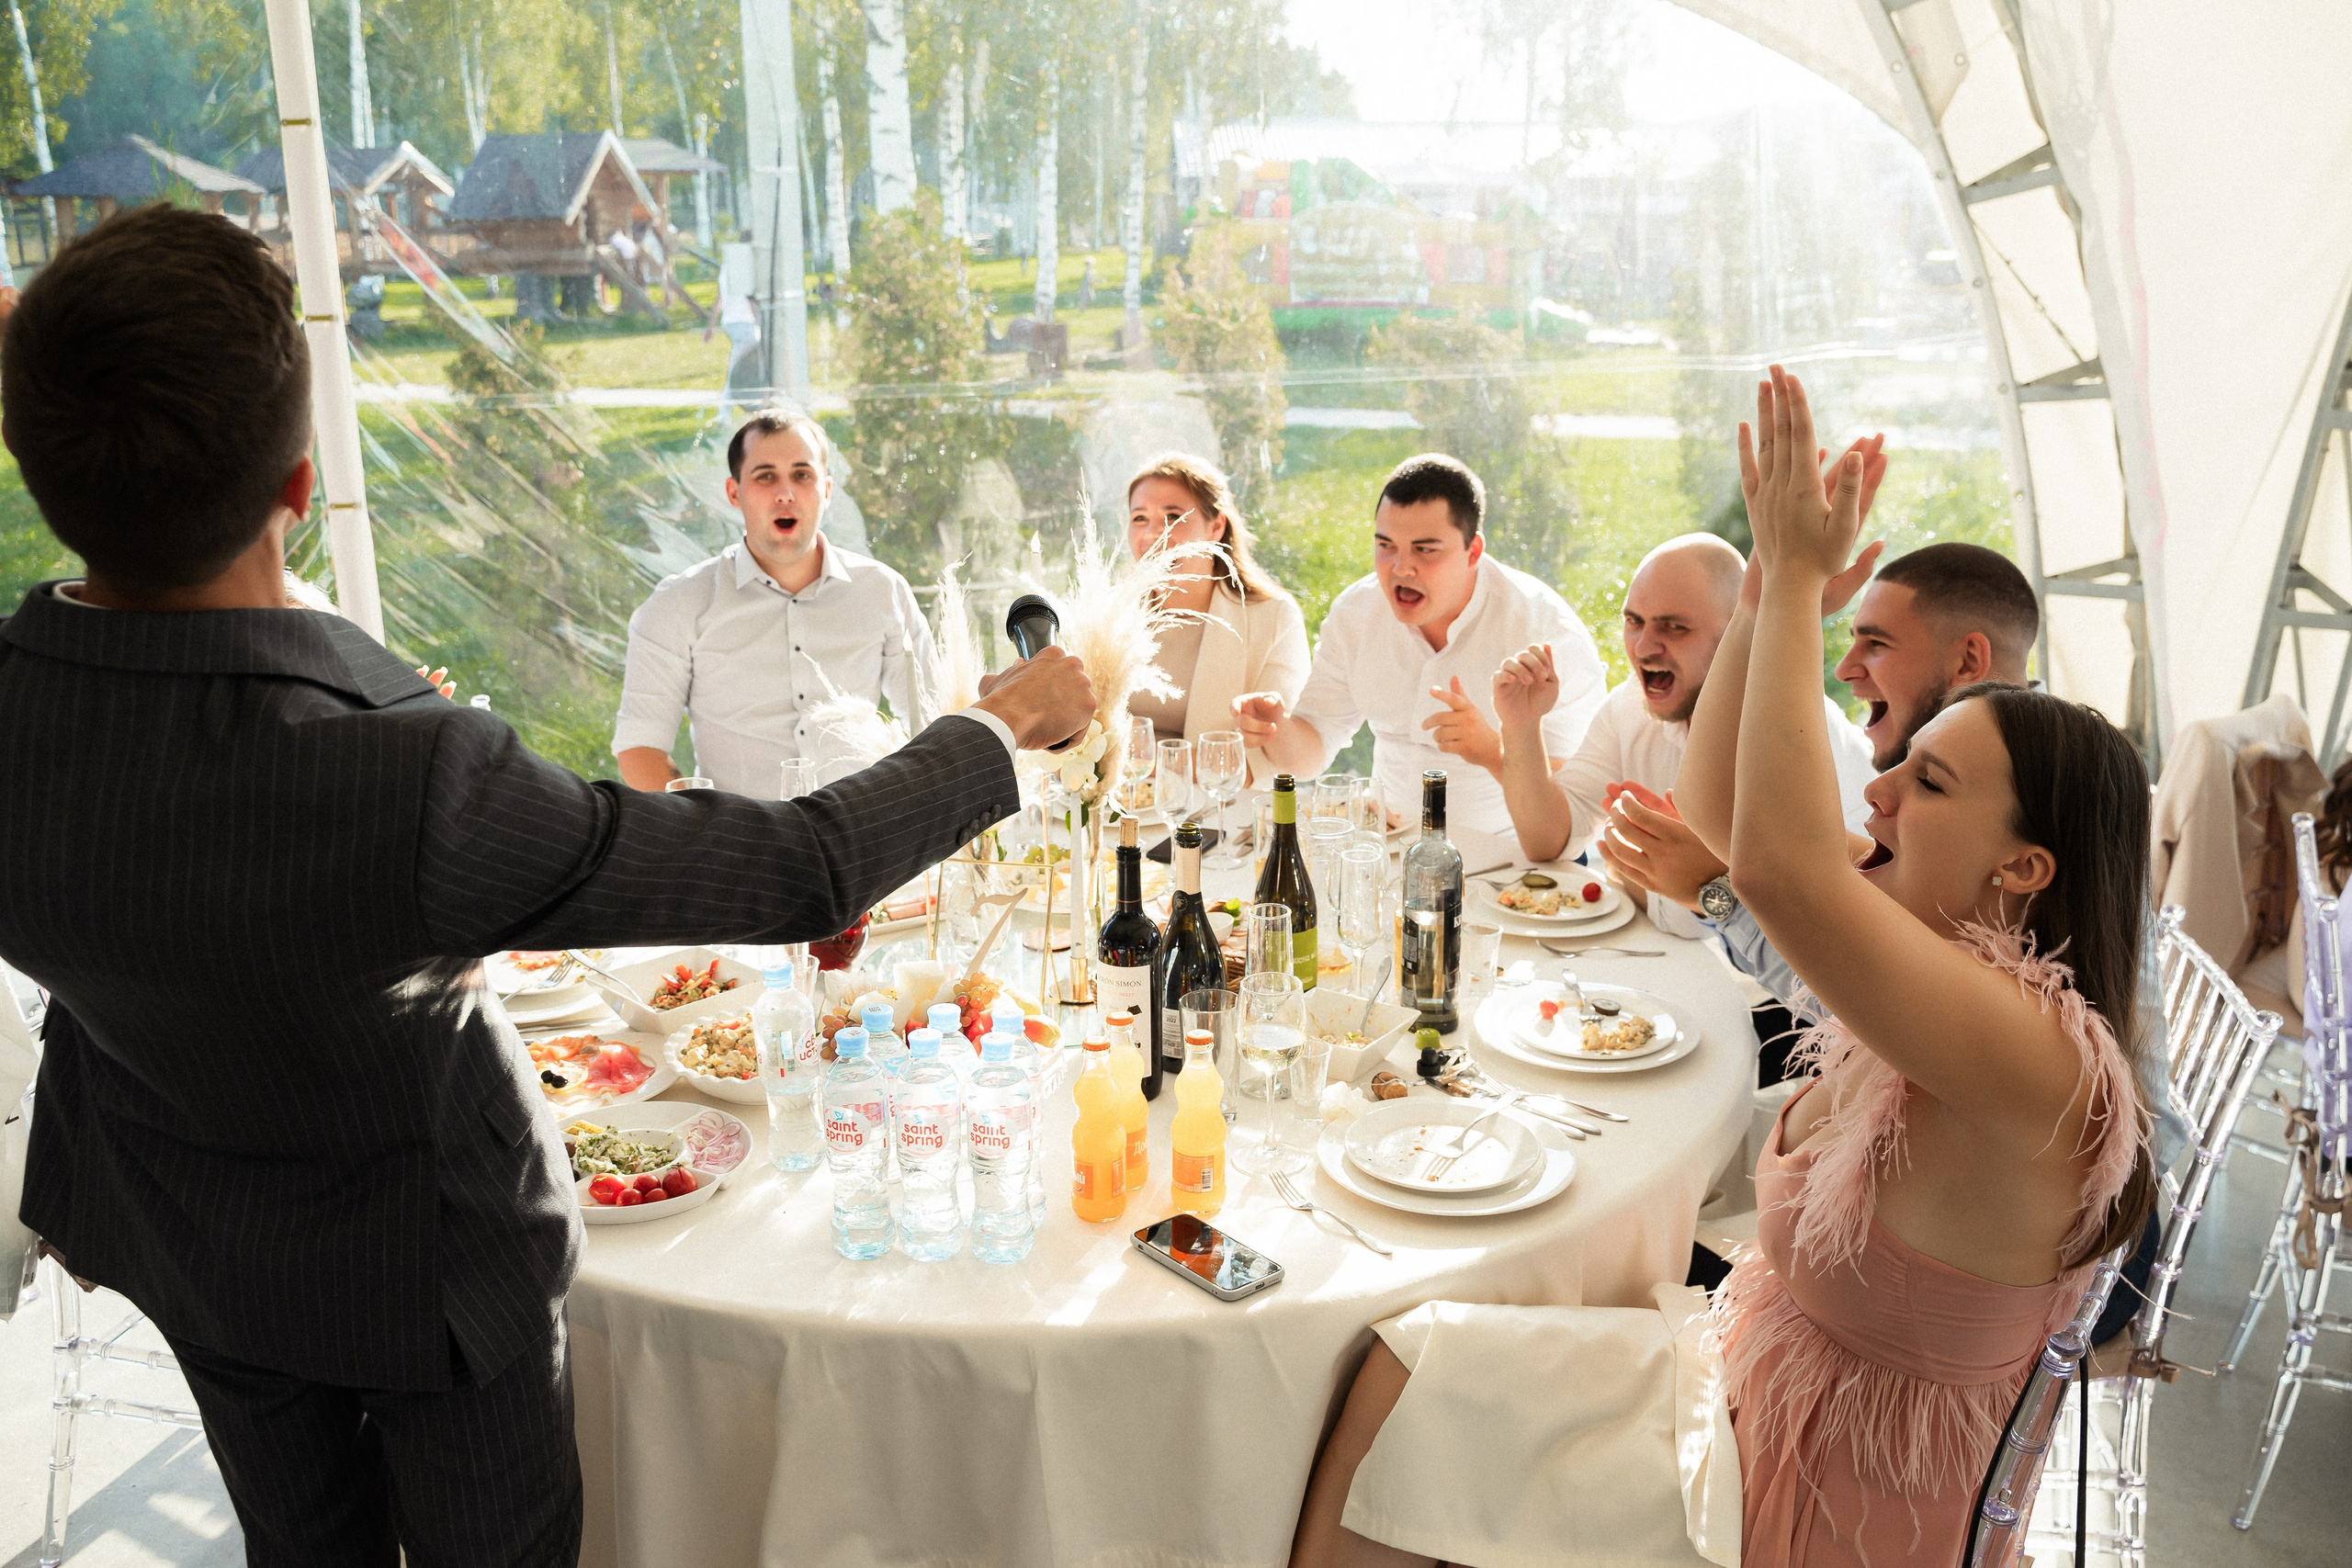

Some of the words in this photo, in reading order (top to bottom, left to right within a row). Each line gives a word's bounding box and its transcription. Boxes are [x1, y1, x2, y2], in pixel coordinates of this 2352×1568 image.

[1115, 979, 1142, 987] SIMÓN
[827, 1119, 857, 1133] saint
[904, 1123, 938, 1135] saint
[972, 1122, 1006, 1135] saint
[826, 1128, 863, 1146] spring
[900, 1133, 943, 1148] spring
[970, 1132, 1011, 1149] spring
